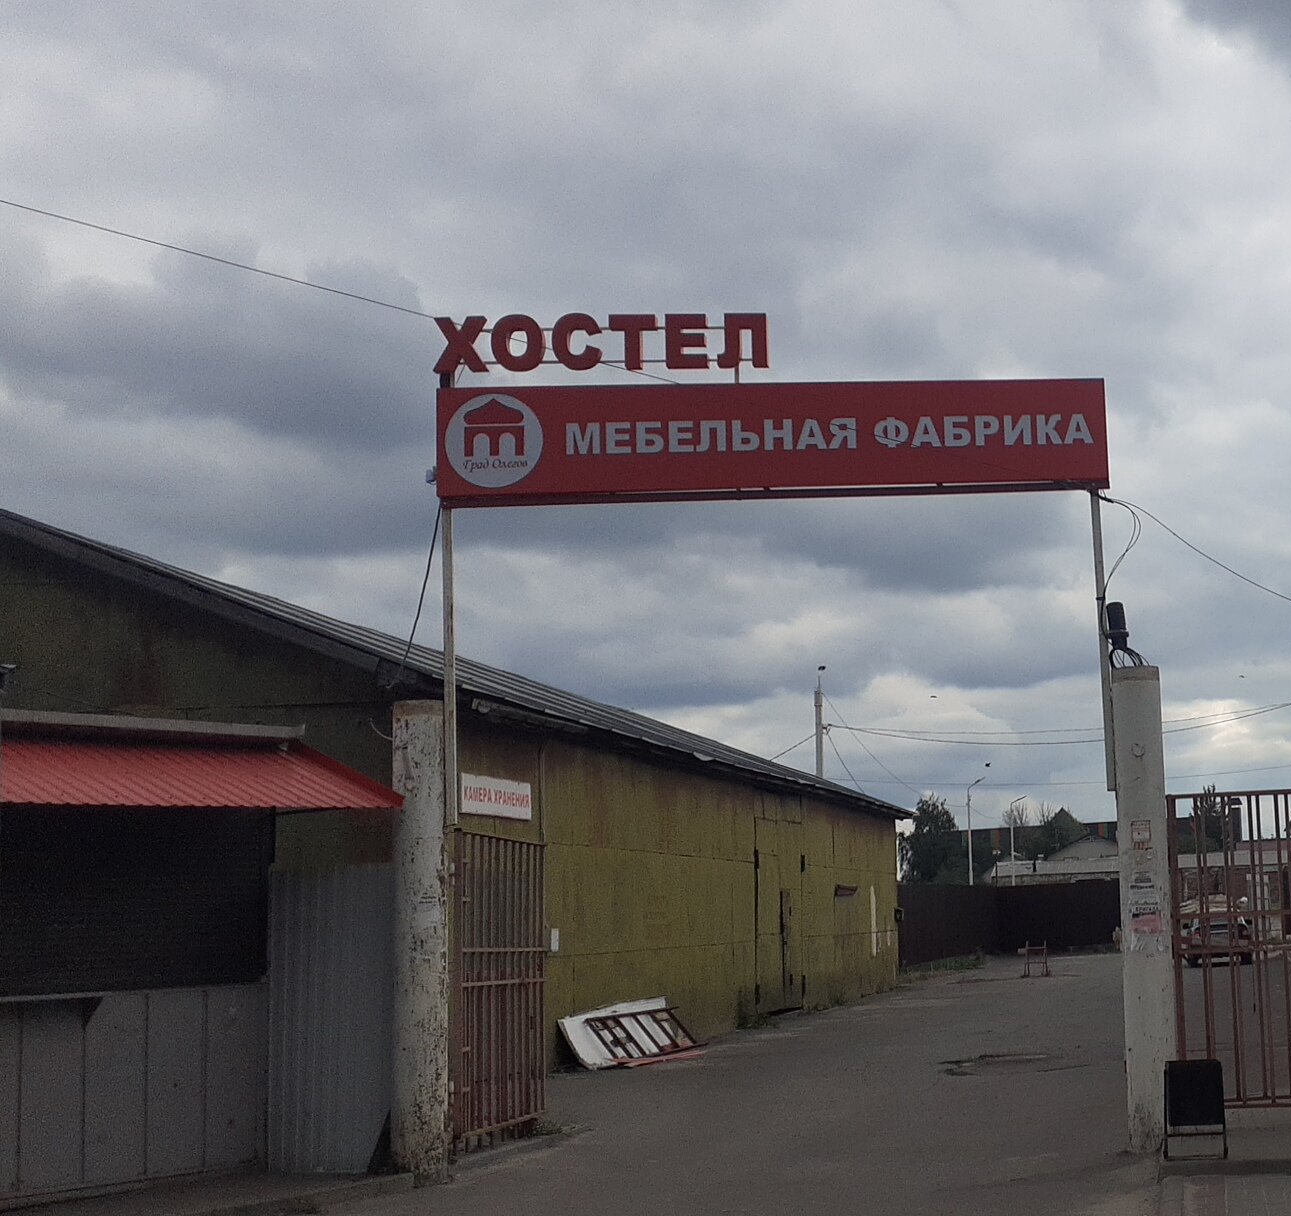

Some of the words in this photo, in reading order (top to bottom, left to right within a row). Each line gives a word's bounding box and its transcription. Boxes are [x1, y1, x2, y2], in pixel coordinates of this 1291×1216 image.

[433, 313, 769, 374] ХОСТЕЛ
[565, 417, 857, 455] МЕБЕЛЬНАЯ
[874, 413, 1093, 449] ФАБРИКА
[462, 458, 490, 473] Град
[463, 785, 493, 803] КАМЕРА
[494, 789, 530, 808] ХРАНЕНИЯ
